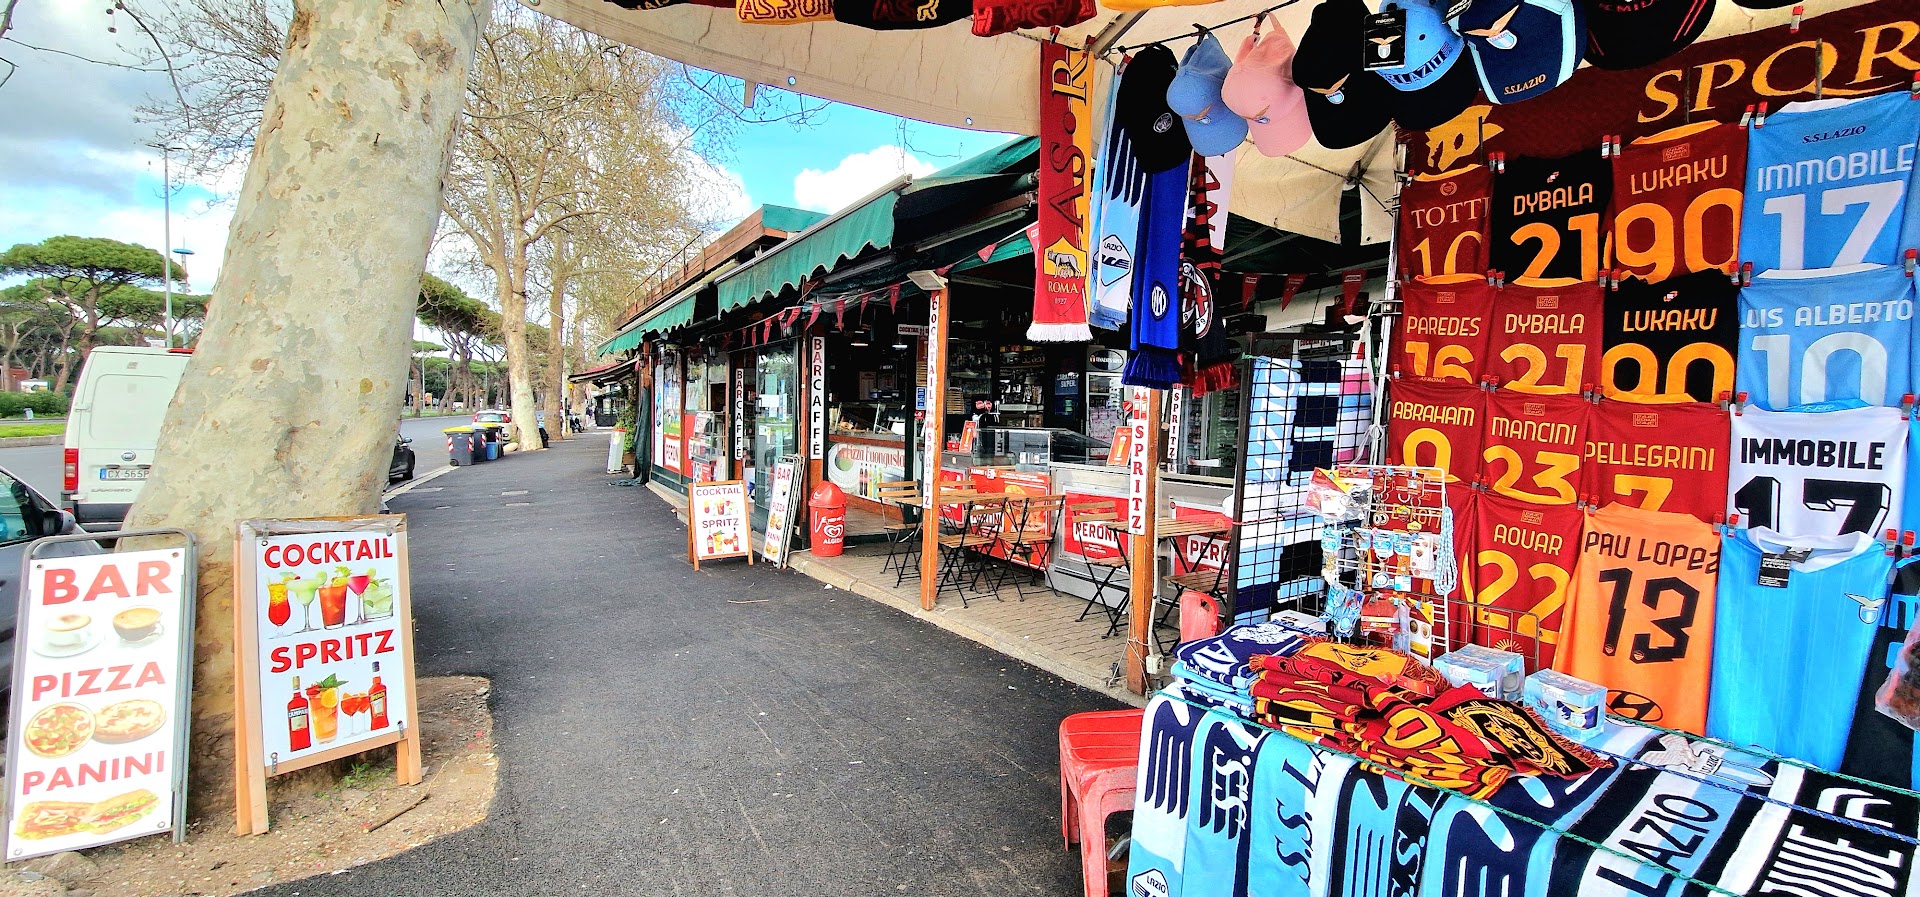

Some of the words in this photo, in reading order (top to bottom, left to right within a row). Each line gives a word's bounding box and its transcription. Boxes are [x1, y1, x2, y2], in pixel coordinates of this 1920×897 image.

[1504, 73, 1546, 95] S.S.LAZIO
[1637, 20, 1920, 123] SPQR
[1802, 125, 1867, 144] S.S.LAZIO
[1631, 155, 1728, 195] LUKAKU
[1757, 143, 1916, 192] IMMOBILE
[1411, 197, 1490, 229] TOTTI
[1513, 182, 1593, 216] DYBALA
[1615, 187, 1743, 284] 90
[1763, 180, 1904, 270] 17
[1412, 231, 1482, 278] 10
[1510, 212, 1599, 282] 21
[1048, 281, 1079, 294] ROMA
[1406, 316, 1481, 337] PAREDES
[1505, 313, 1585, 335] DYBALA
[1623, 308, 1718, 332] LUKAKU
[1739, 307, 1784, 329] UIS
[1794, 299, 1914, 328] ALBERTO
[929, 301, 938, 400] COCKTAIL
[1405, 341, 1474, 384] 16
[1500, 343, 1586, 394] 21
[1751, 331, 1888, 409] 10
[1169, 392, 1180, 458] SPRITZ
[1392, 401, 1475, 427] ABRAHAM
[1491, 417, 1577, 445] MANCINI
[1584, 441, 1714, 472] PELLEGRINI
[1740, 437, 1886, 470] IMMOBILE
[108, 470, 120, 478] CX
[696, 487, 741, 497] COCKTAIL
[777, 467, 791, 481] BAR
[1131, 425, 1144, 530] SPRITZ
[1483, 445, 1580, 502] 23
[1613, 473, 1673, 512] 7
[702, 518, 739, 529] SPRITZ
[771, 501, 785, 513] PIZZA
[1734, 475, 1892, 538] 17
[264, 537, 393, 569] COCKTAIL
[1494, 523, 1563, 556] AOUAR
[1584, 530, 1630, 558] PAU
[42, 560, 173, 606] BAR
[1477, 550, 1570, 645] 22
[1598, 567, 1700, 664] 13
[270, 629, 395, 674] SPRITZ
[32, 662, 165, 702] PIZZA
[22, 751, 165, 795] PANINI
[1596, 794, 1719, 894] LAZIO
[1146, 875, 1166, 894] LAZIO
